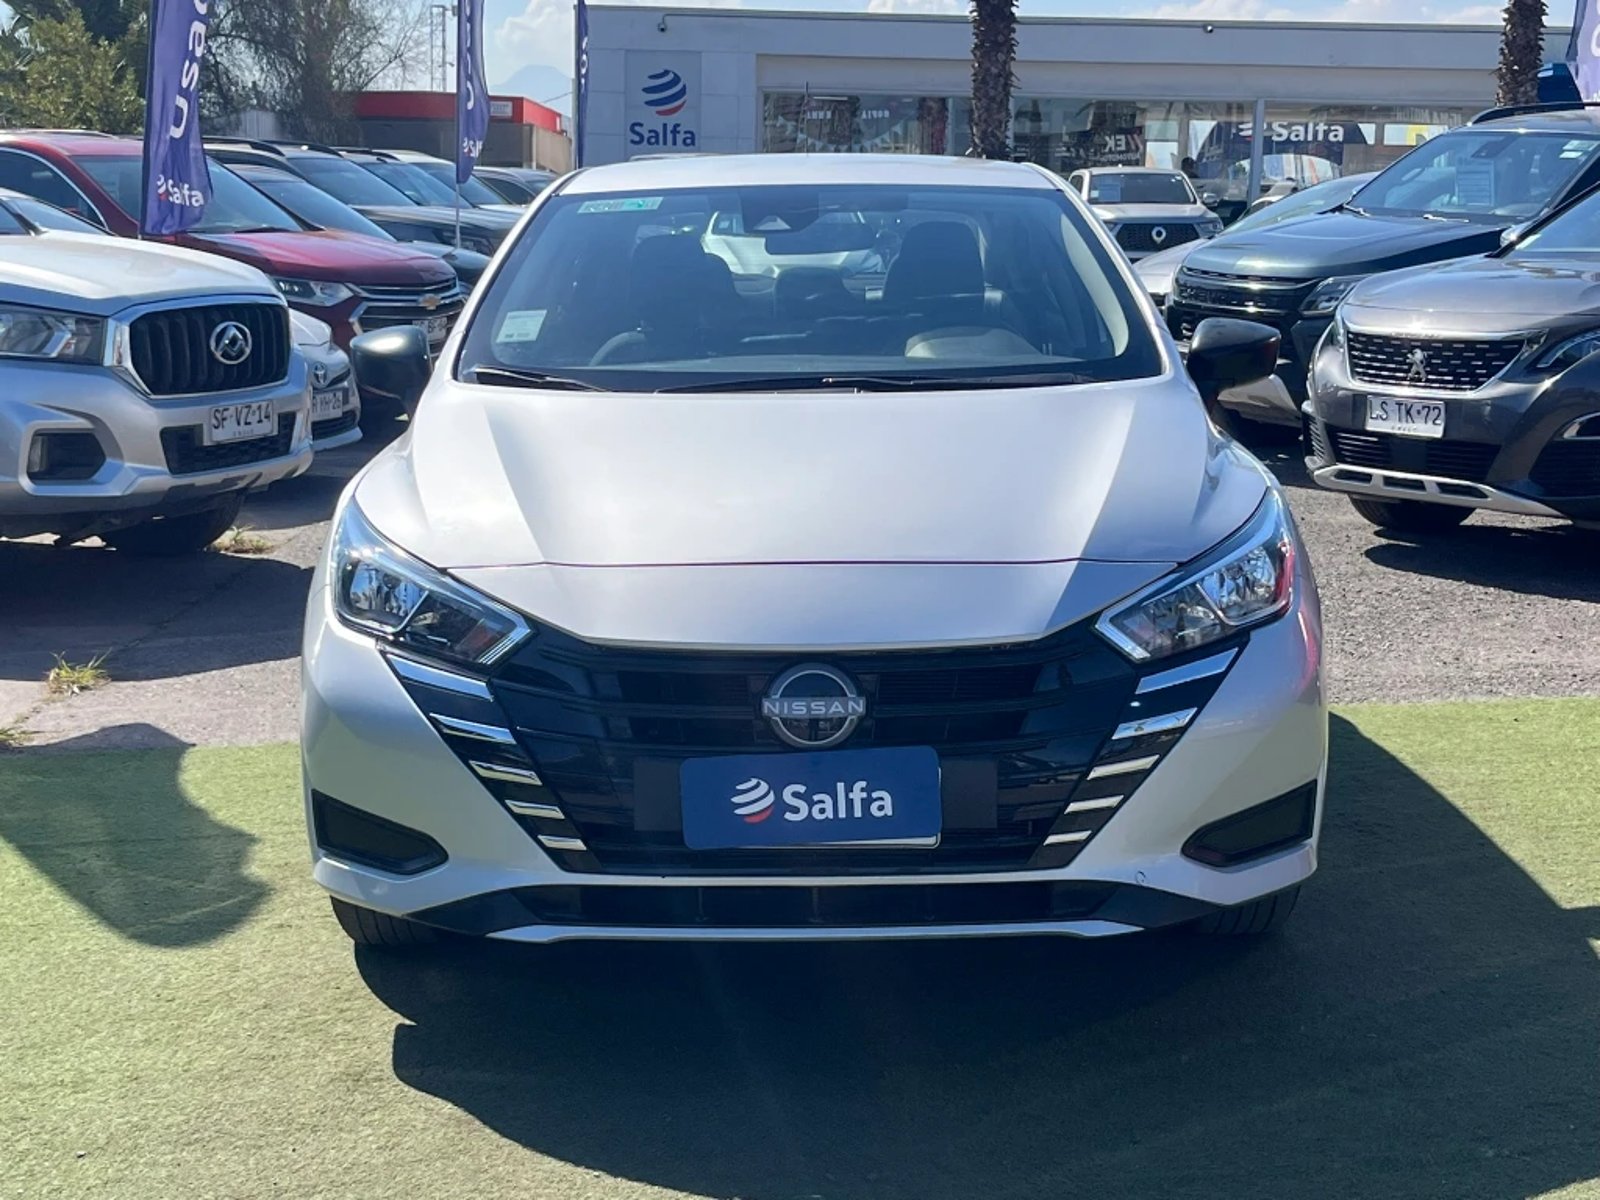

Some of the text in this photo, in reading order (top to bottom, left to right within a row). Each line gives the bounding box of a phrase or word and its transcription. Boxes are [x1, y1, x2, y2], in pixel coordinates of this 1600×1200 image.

[629, 121, 697, 147] Salfa
[1271, 121, 1344, 142] Salfa
[762, 699, 865, 716] NISSAN
[781, 780, 893, 822] Salfa
